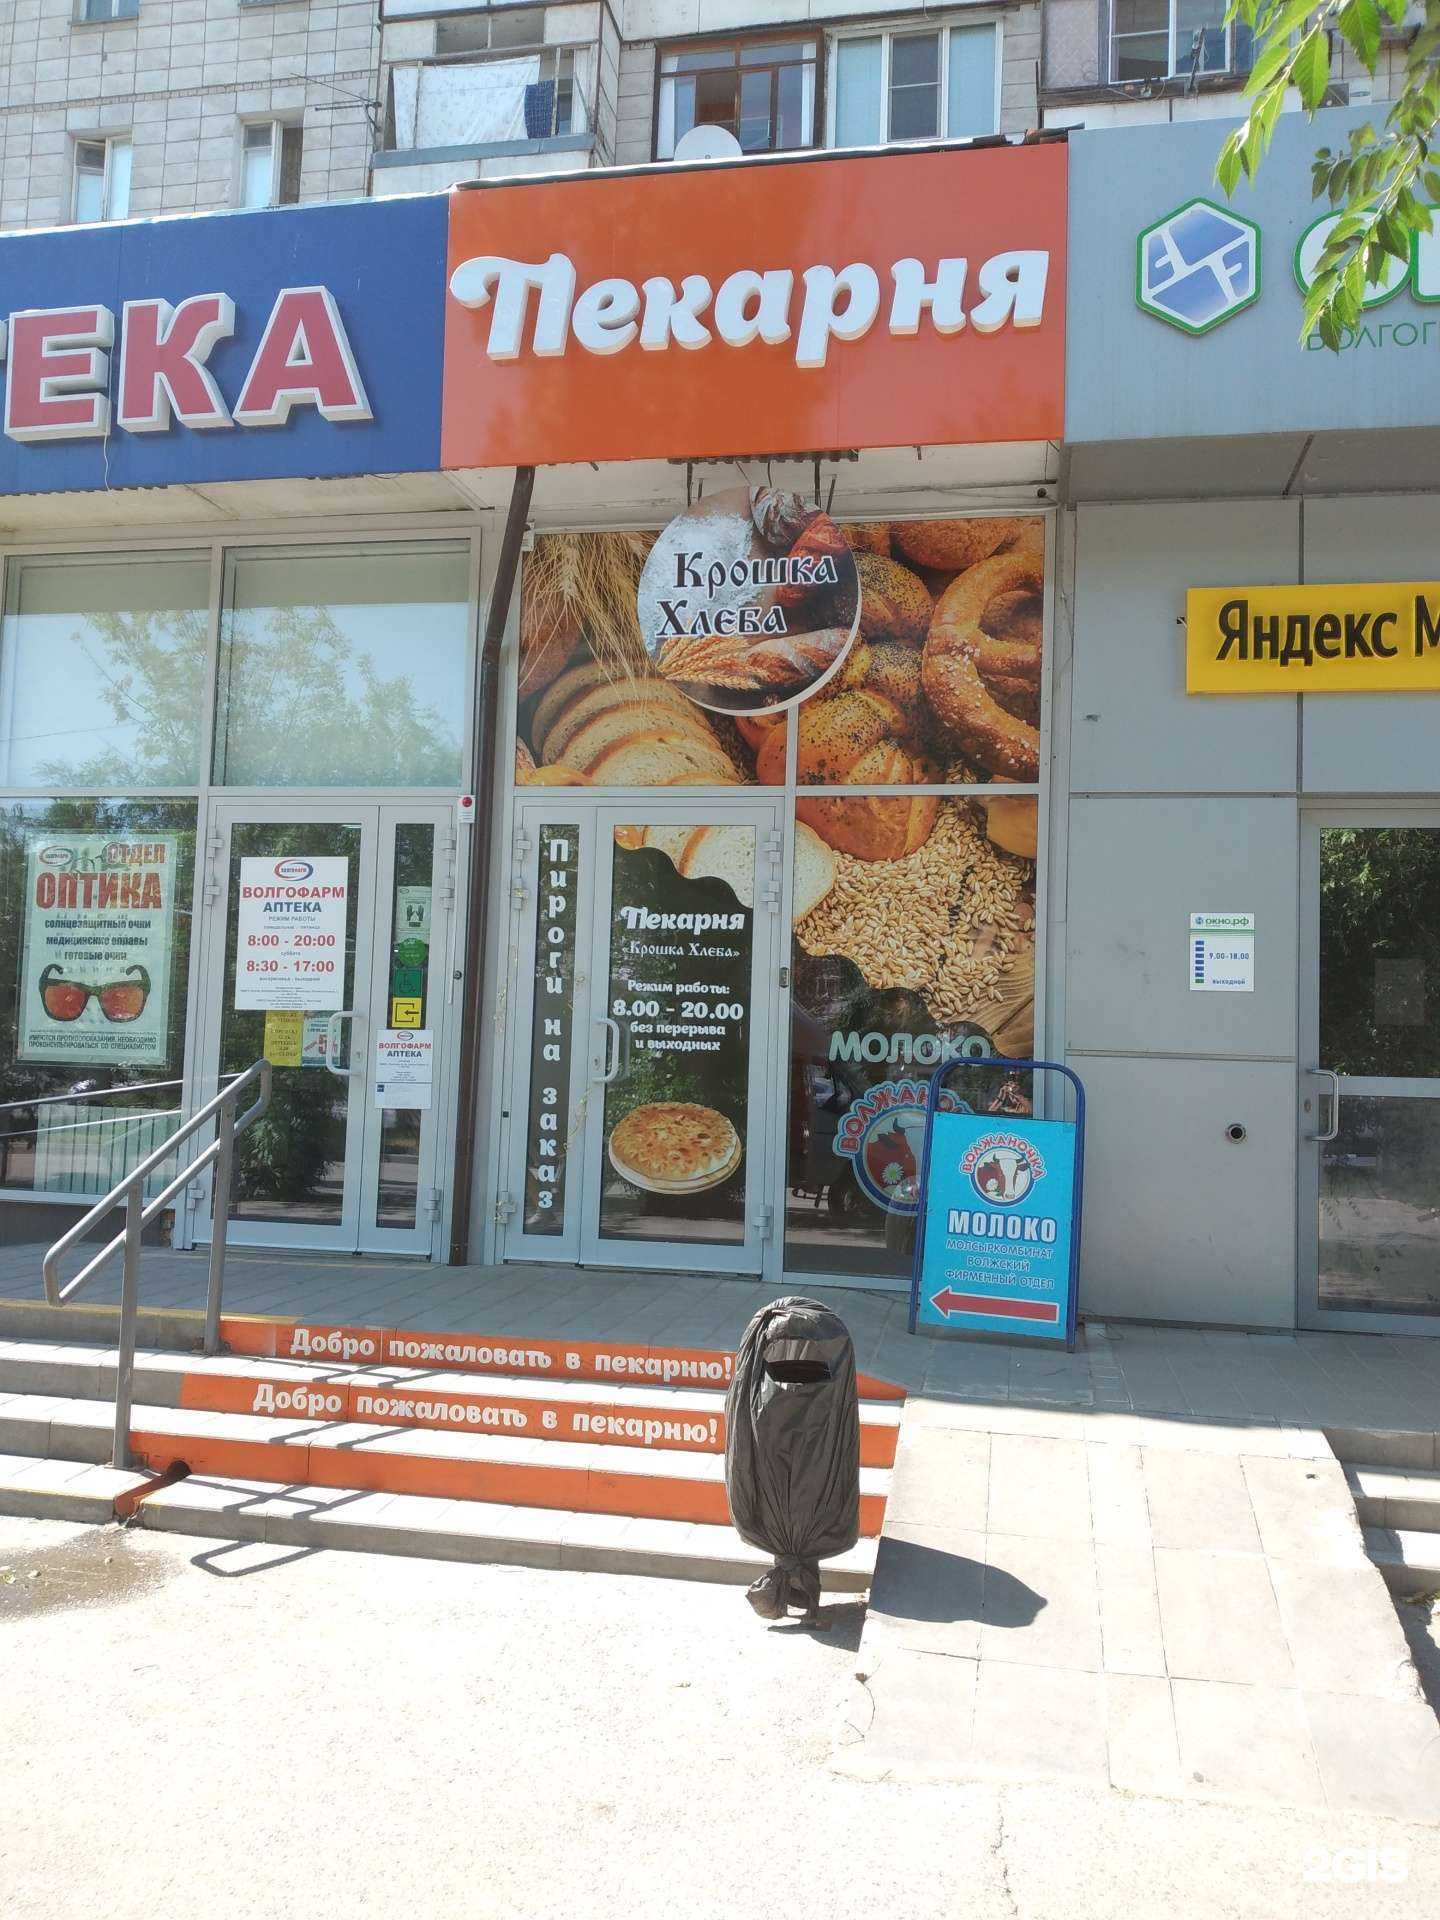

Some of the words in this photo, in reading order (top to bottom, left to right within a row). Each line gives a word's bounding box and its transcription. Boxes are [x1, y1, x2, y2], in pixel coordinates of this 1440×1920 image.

[449, 250, 1050, 368] Пекарня
[0, 285, 374, 442] ЕКА
[672, 551, 838, 598] Крошка
[655, 599, 788, 637] Хлеба
[1215, 600, 1399, 667] Яндекс
[106, 843, 166, 866] ОТДЕЛ
[36, 872, 162, 909] ОПТИКА
[242, 886, 345, 898] ВОЛГОФАРМ
[263, 902, 322, 913] АПТЕКА
[546, 839, 569, 994] Пироги
[620, 905, 745, 935] Пекарня
[248, 935, 279, 946] 8:00
[294, 935, 336, 946] 20:00
[246, 961, 278, 972] 8:30
[294, 961, 335, 972] 17:00
[627, 980, 672, 992] Режим
[676, 981, 730, 995] работы:
[612, 999, 660, 1016] 8.00
[681, 1001, 744, 1020] 20.00
[543, 1018, 562, 1062] на
[630, 1020, 653, 1033] без
[656, 1022, 726, 1037] перерыва
[378, 1042, 432, 1050] ВОЛГОФАРМ
[387, 1050, 422, 1058] АПТЕКА
[635, 1039, 644, 1049] и
[647, 1039, 721, 1051] выходных
[828, 1030, 991, 1066] МОЛОКО
[538, 1087, 558, 1209] заказ
[947, 1210, 1057, 1243] МОЛОКО
[946, 1239, 1053, 1259] МОЛСЫРКОМБИНАТ
[967, 1256, 1030, 1272] ВОЛЖСКИЙ
[945, 1270, 1016, 1285] ФИРМЕННЫЙ
[1019, 1277, 1054, 1289] ОТДЕЛ
[290, 1328, 375, 1360] Добро
[388, 1336, 552, 1369] пожаловать
[565, 1352, 581, 1370] в
[594, 1355, 732, 1382] пекарню!
[252, 1383, 342, 1417] Добро
[355, 1395, 527, 1428] пожаловать
[542, 1409, 558, 1429] в
[572, 1411, 719, 1444] пекарню!
